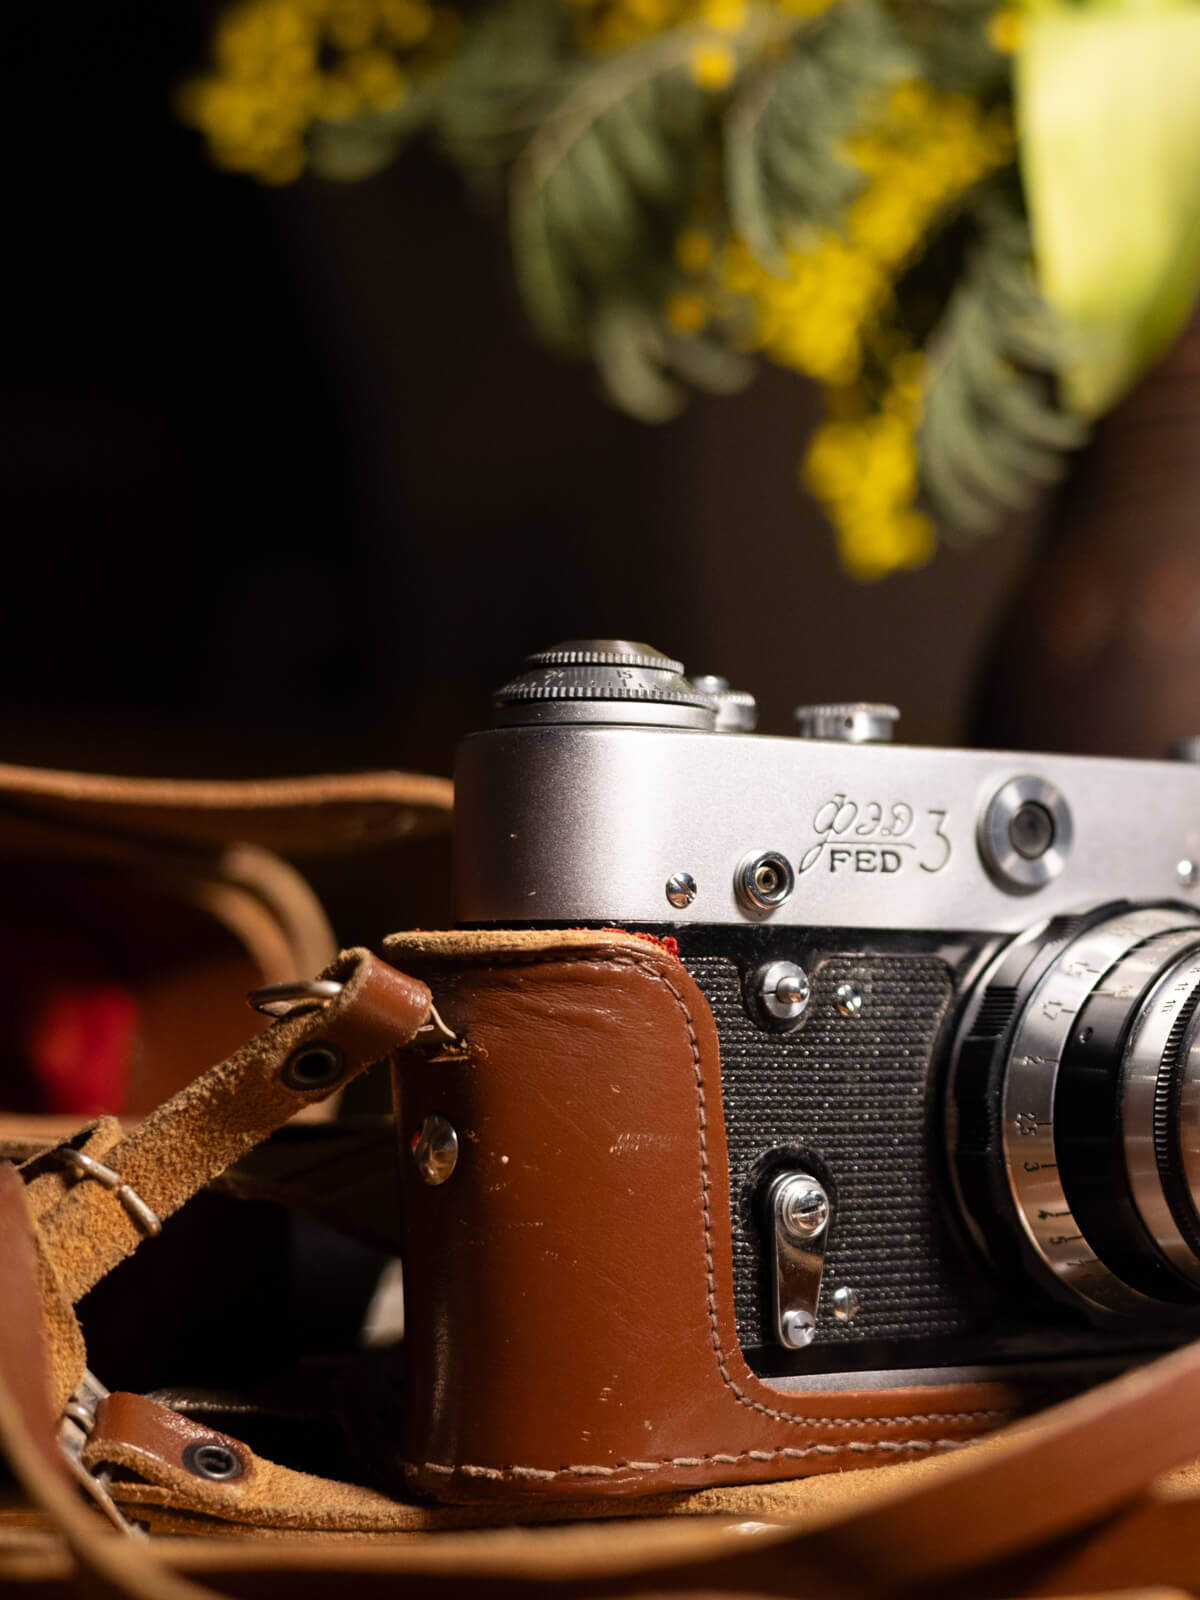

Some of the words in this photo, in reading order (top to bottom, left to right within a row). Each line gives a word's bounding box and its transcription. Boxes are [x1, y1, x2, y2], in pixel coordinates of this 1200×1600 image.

[919, 810, 952, 873] 3
[829, 850, 902, 873] FED
[1023, 1161, 1040, 1173] 3
